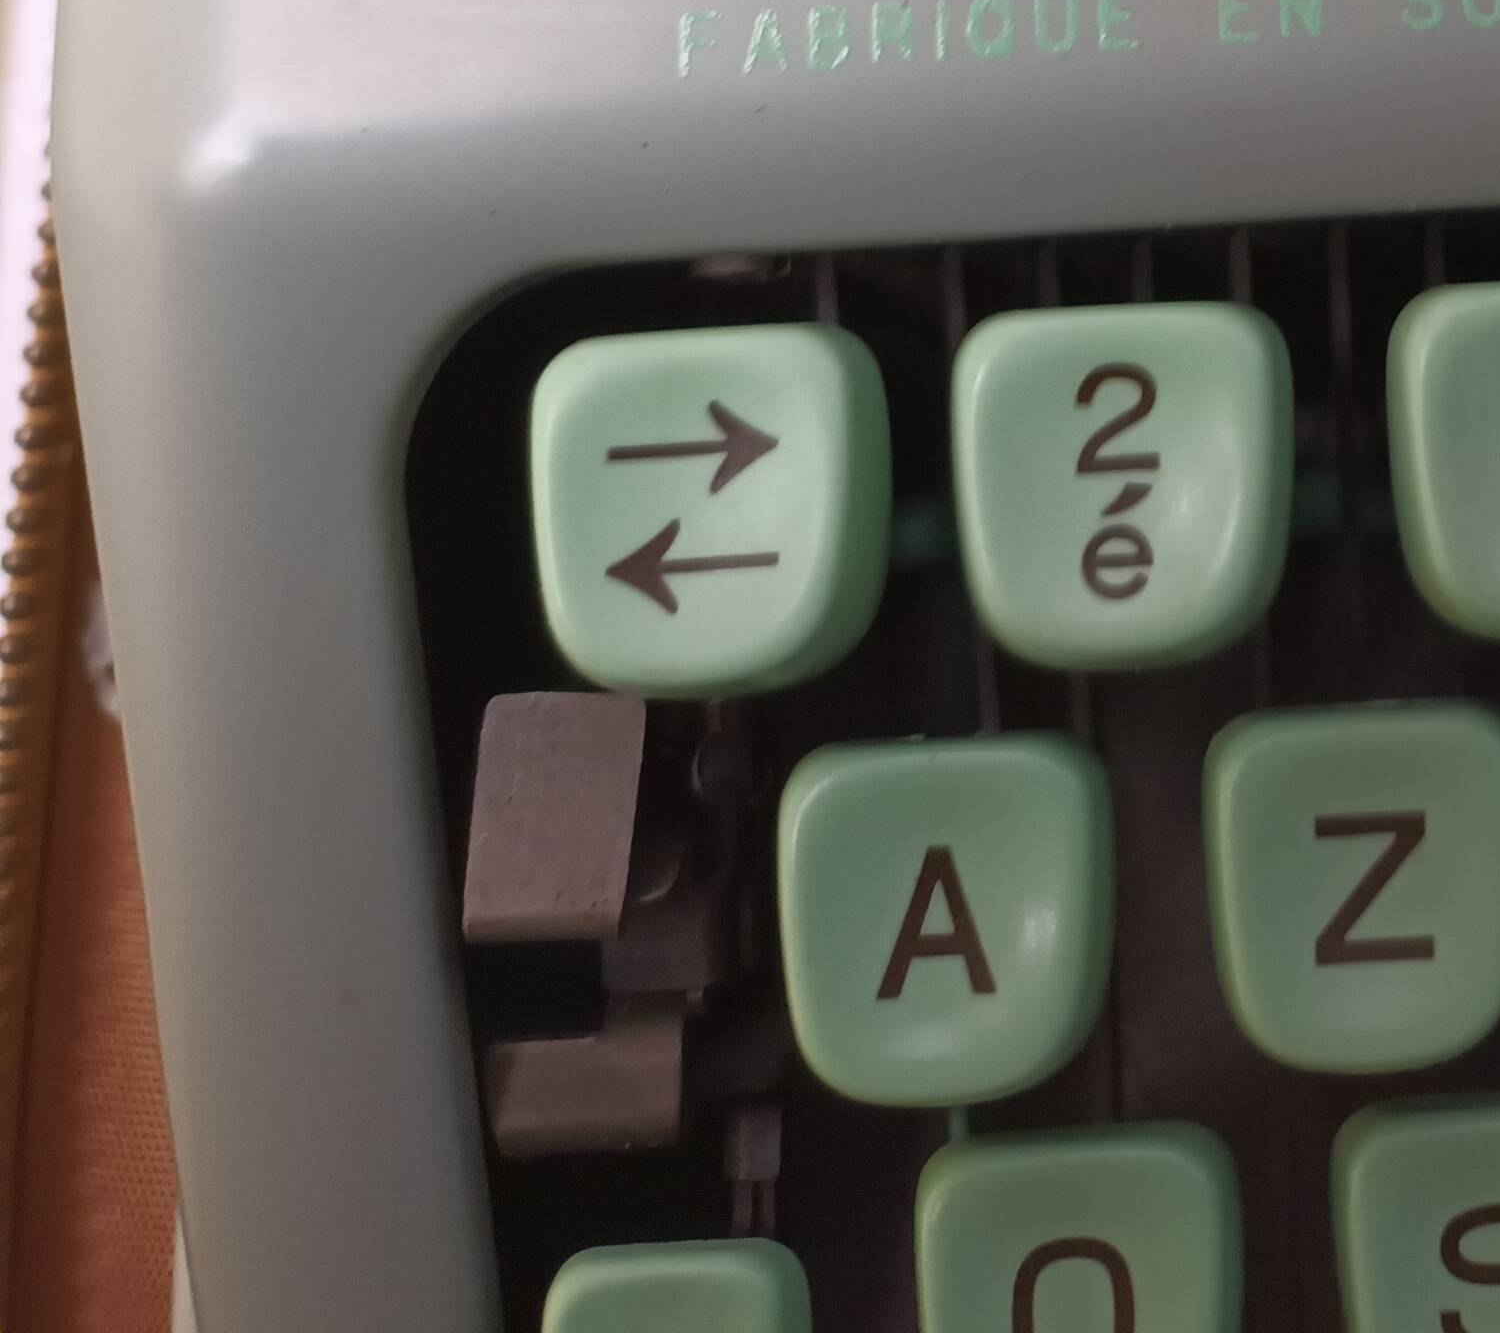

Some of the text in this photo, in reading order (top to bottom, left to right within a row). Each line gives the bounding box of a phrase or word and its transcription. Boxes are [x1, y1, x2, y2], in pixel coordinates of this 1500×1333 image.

[1074, 362, 1161, 475] 2
[875, 844, 997, 1002] A
[1313, 809, 1437, 966] Z
